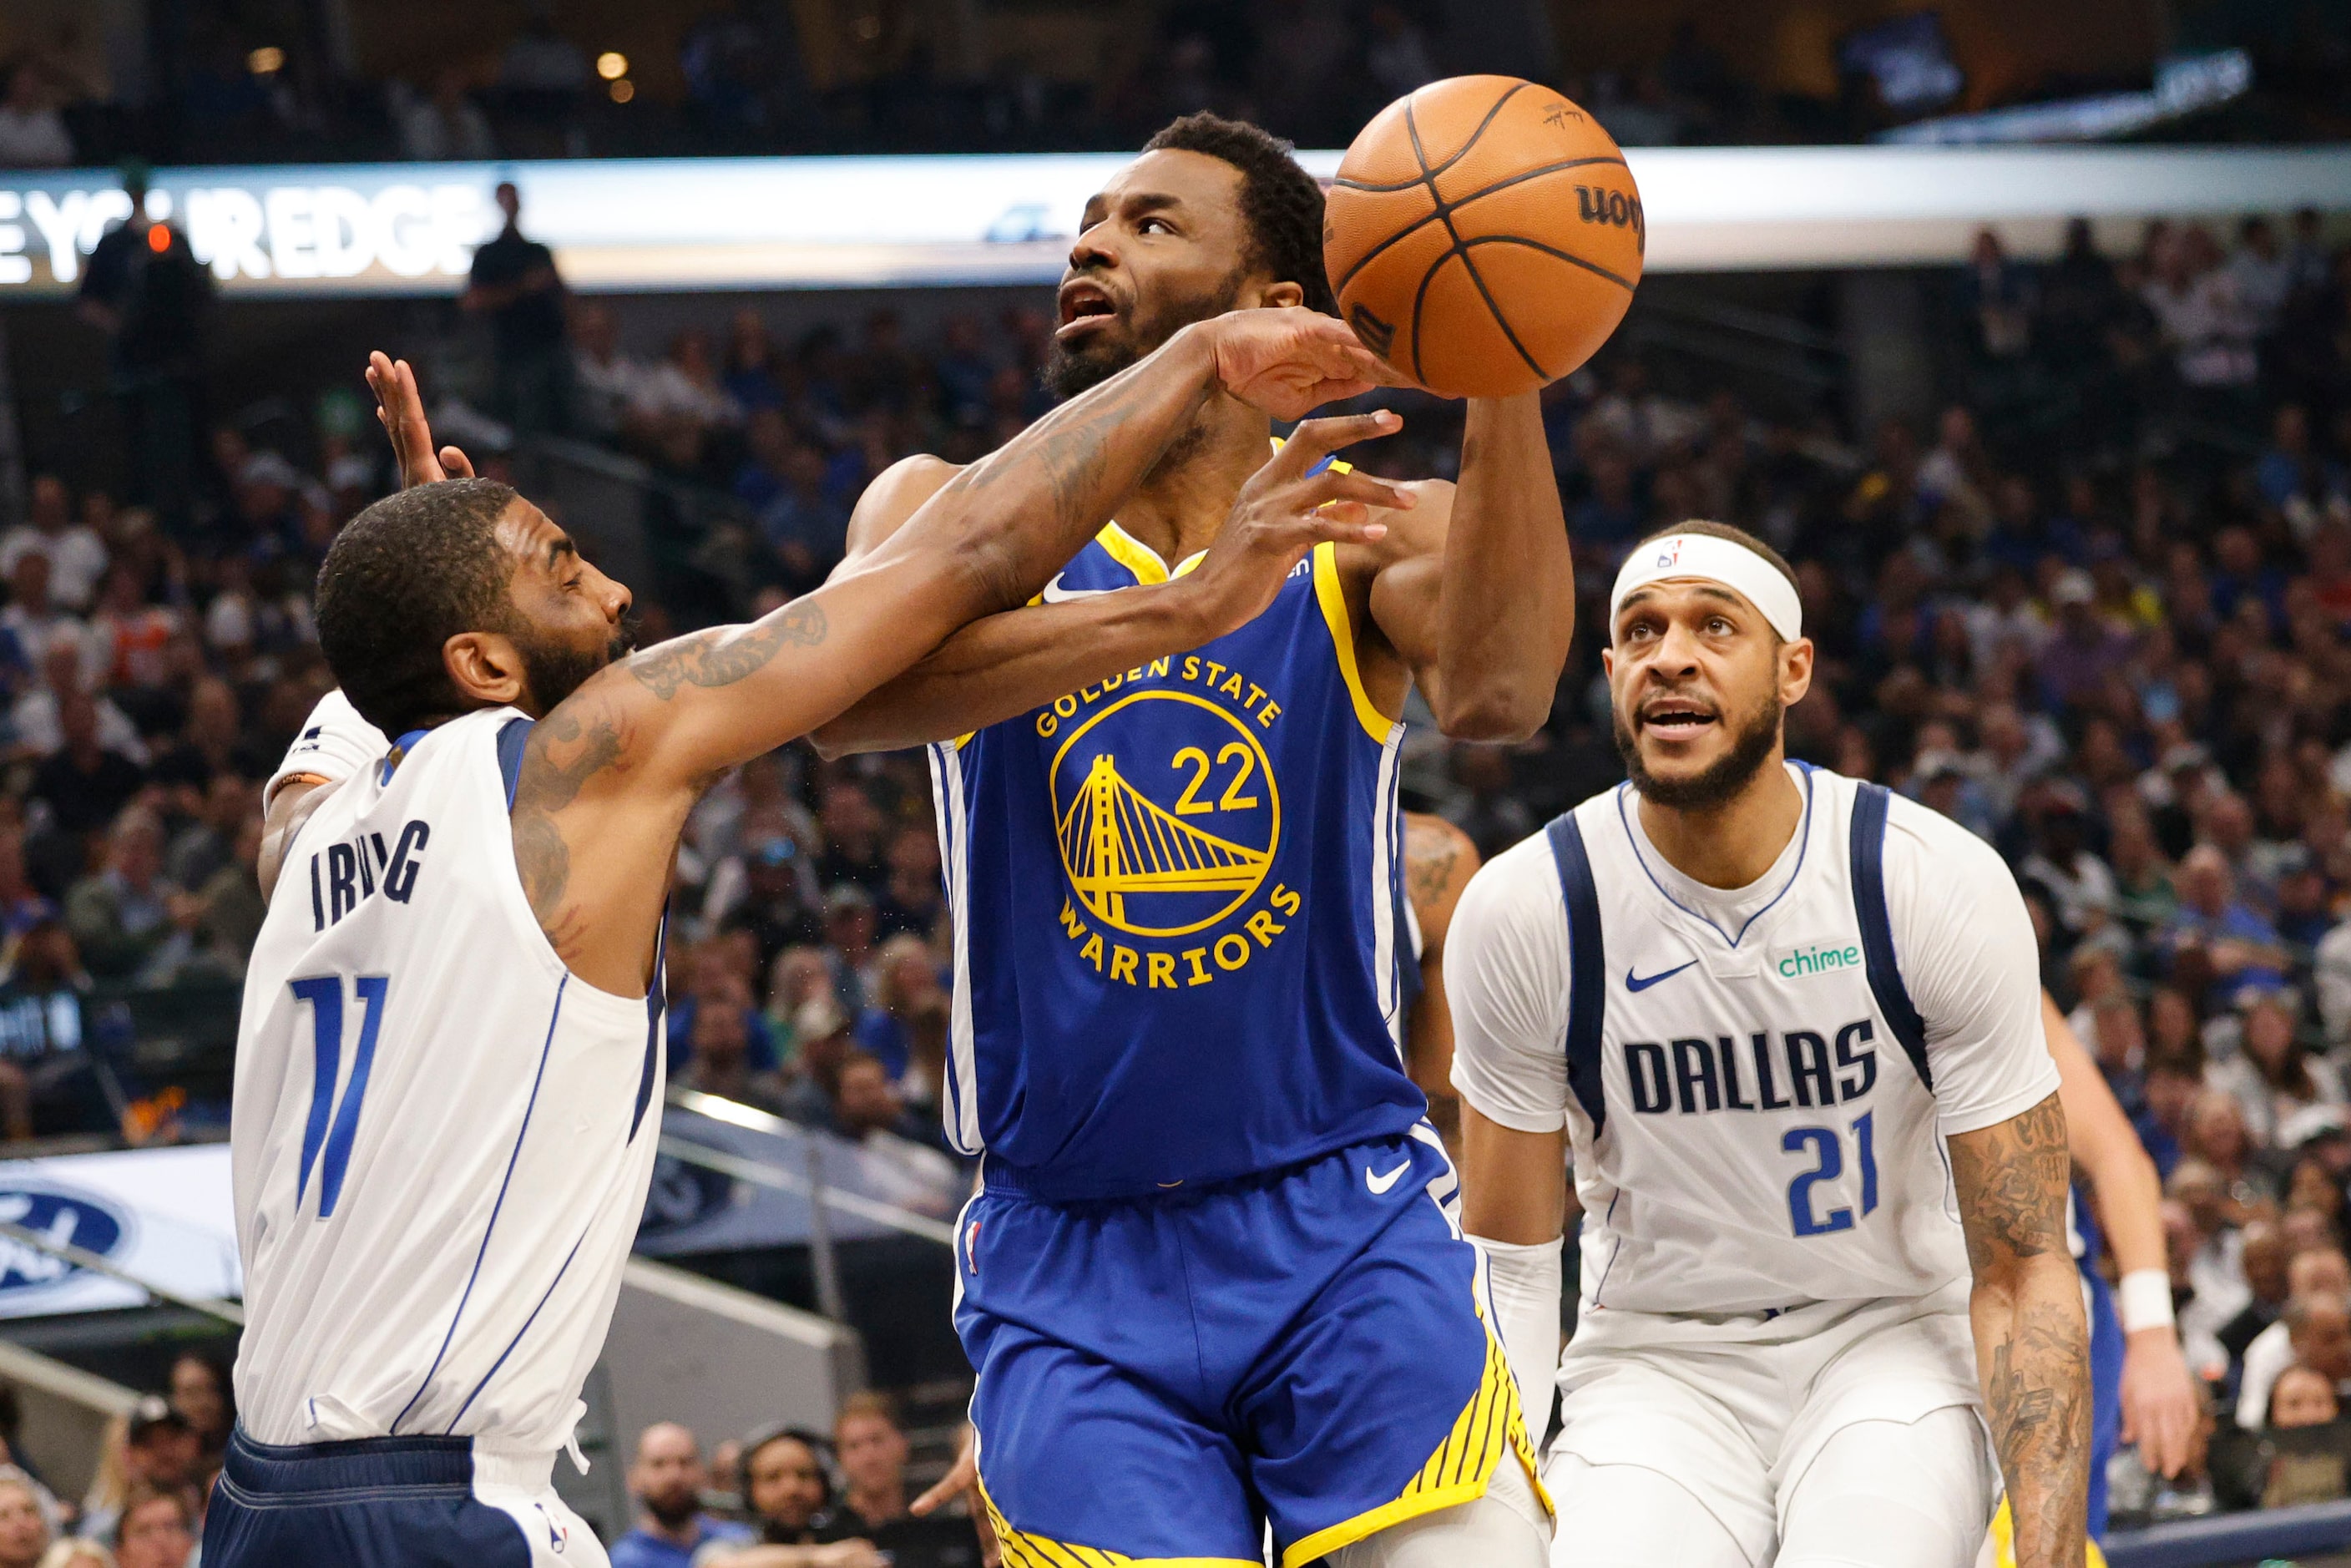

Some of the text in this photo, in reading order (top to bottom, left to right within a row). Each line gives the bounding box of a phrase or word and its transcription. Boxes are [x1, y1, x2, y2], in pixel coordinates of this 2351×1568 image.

[1035, 655, 1282, 738] GOLDEN STATE
[1171, 742, 1258, 816] 22
[1058, 882, 1302, 989] WARRIORS
[1778, 946, 1861, 979] chime
[289, 975, 390, 1222] 11
[1621, 1016, 1878, 1116] DALLAS
[1780, 1107, 1878, 1239] 21
